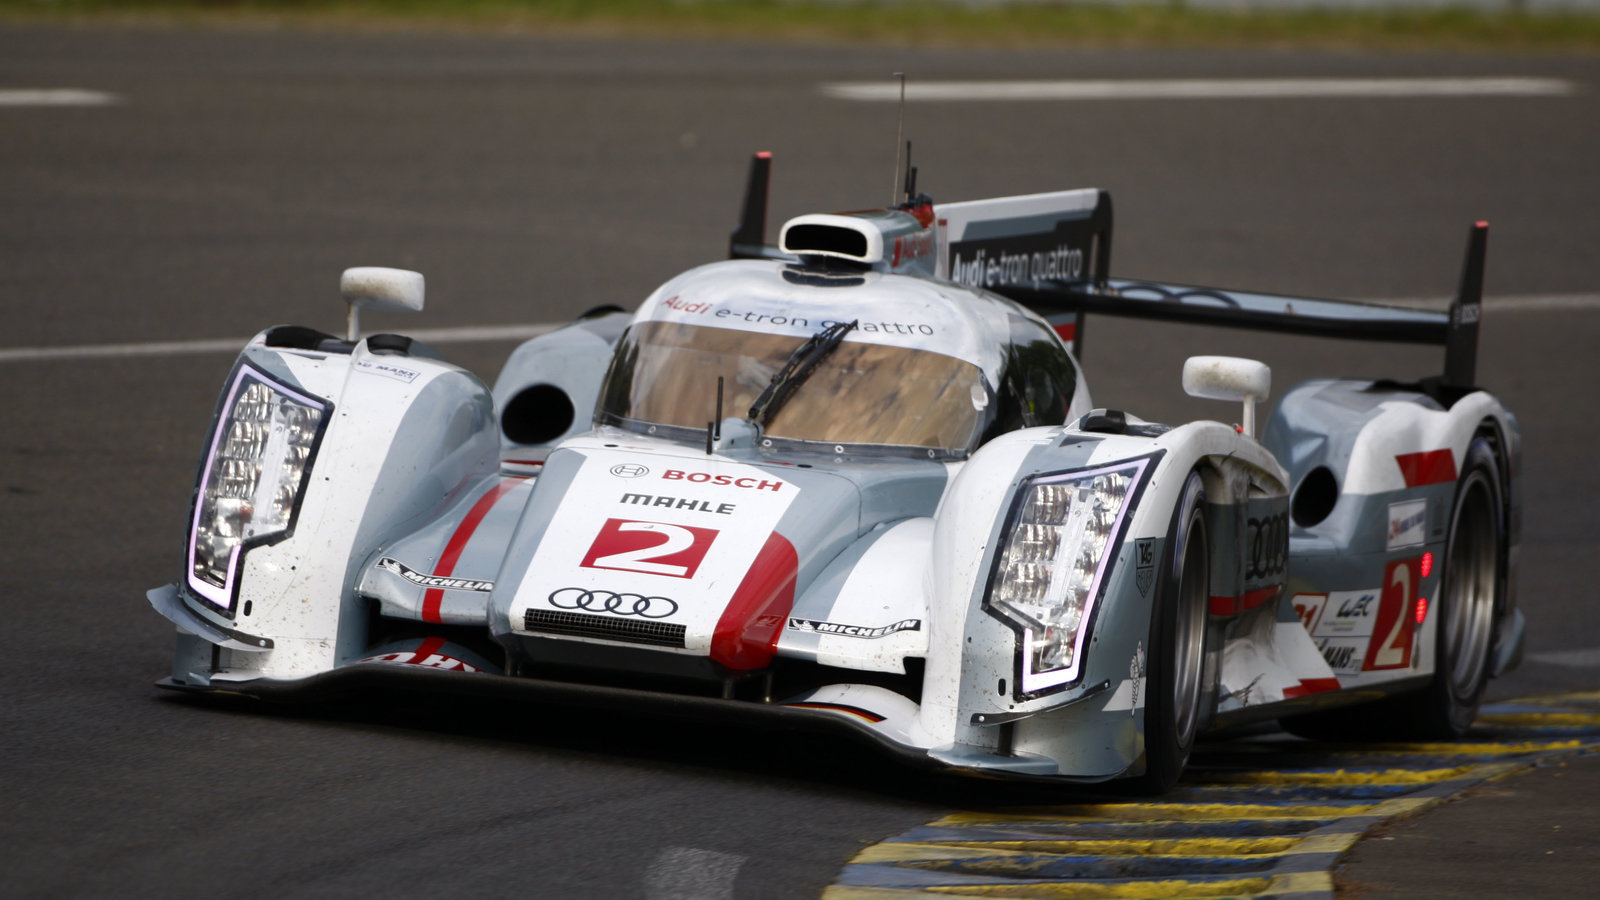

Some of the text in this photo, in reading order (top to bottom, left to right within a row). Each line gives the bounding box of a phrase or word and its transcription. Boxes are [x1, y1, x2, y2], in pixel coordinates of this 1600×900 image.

[953, 244, 1082, 291] Audi e-tron quattro
[662, 295, 713, 314] Audi
[715, 308, 808, 325] e-tron
[661, 469, 783, 492] BOSCH
[620, 492, 736, 515] MAHLE
[593, 522, 696, 577] 2
[1139, 542, 1153, 565] TAG
[403, 570, 495, 590] MICHELIN
[1374, 563, 1410, 667] 2
[817, 619, 917, 637] MICHELIN
